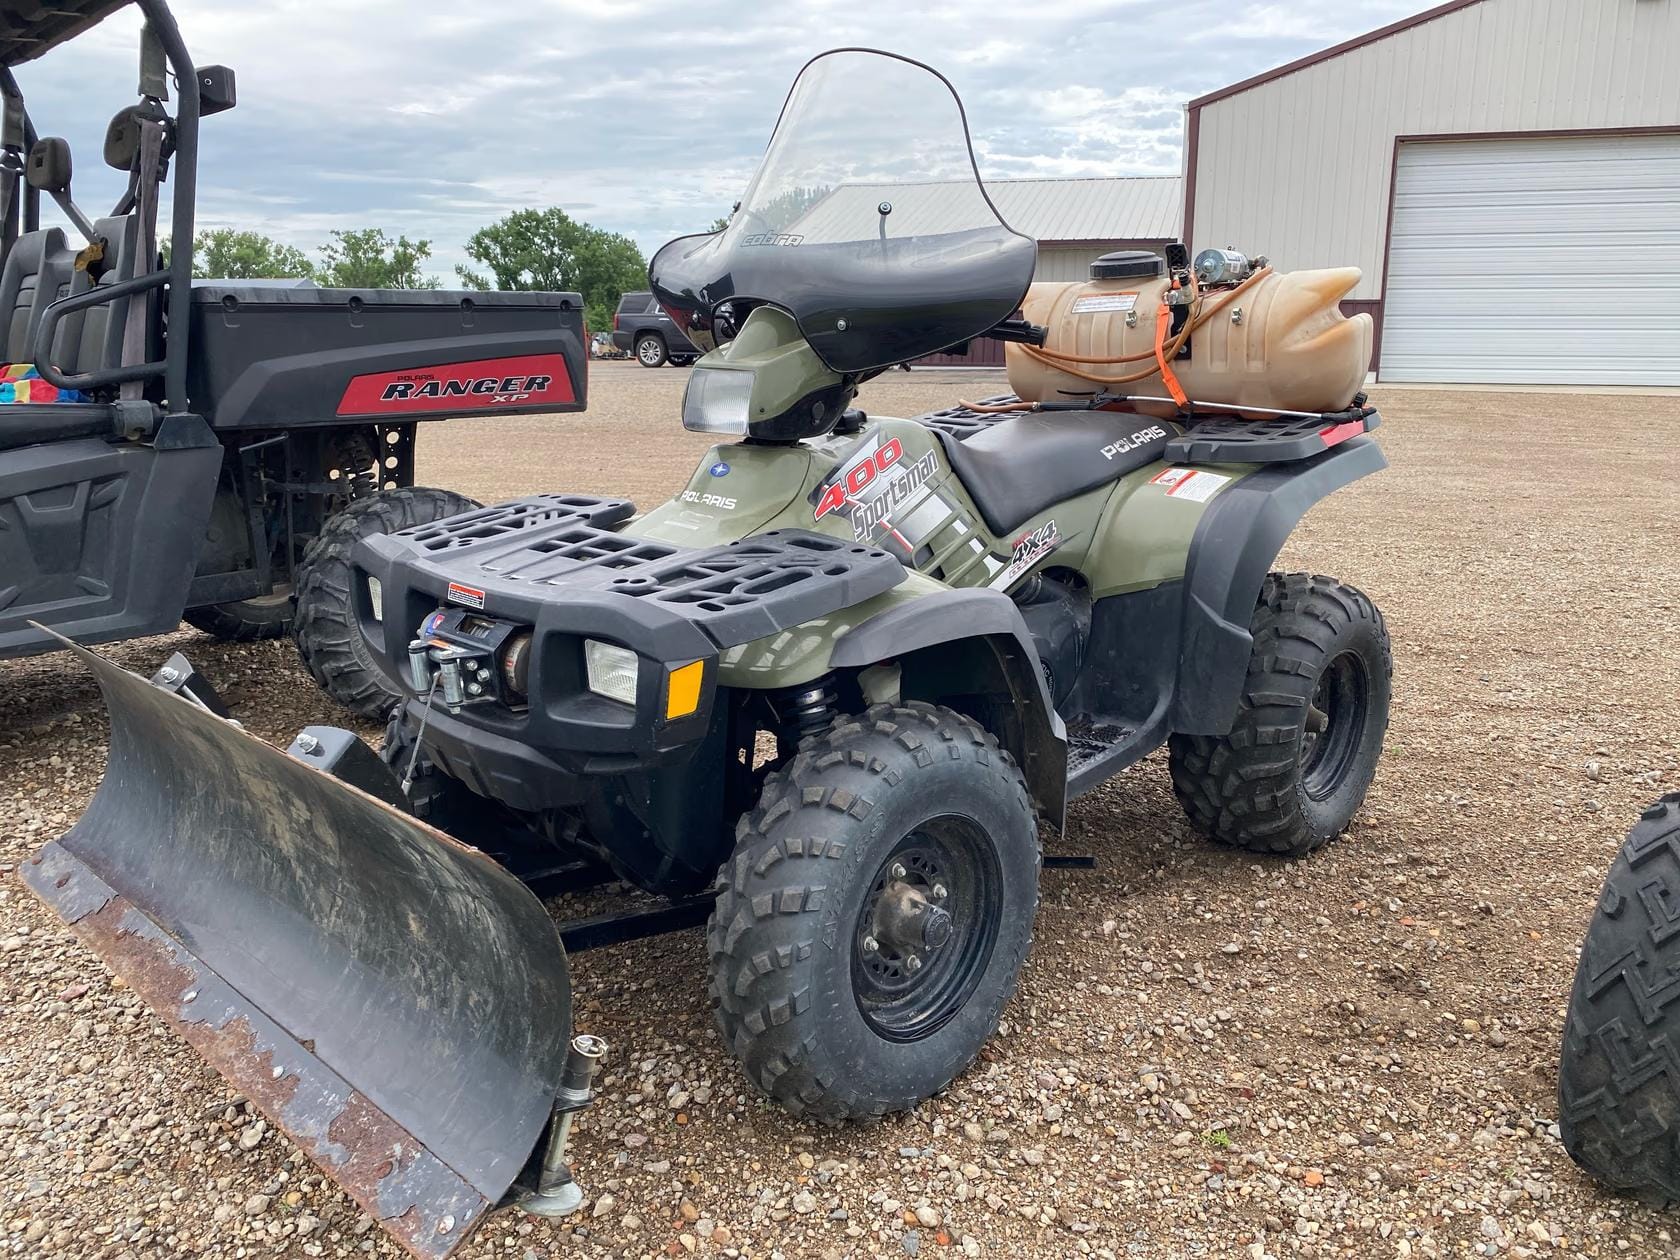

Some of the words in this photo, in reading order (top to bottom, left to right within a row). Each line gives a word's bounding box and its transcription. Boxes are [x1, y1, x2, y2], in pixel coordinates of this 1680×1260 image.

[380, 375, 552, 400] RANGER
[489, 393, 529, 403] XP
[1100, 425, 1167, 460] POLARIS
[814, 437, 904, 522] 400
[679, 490, 737, 510] POLARIS
[851, 448, 939, 542] Sportsman
